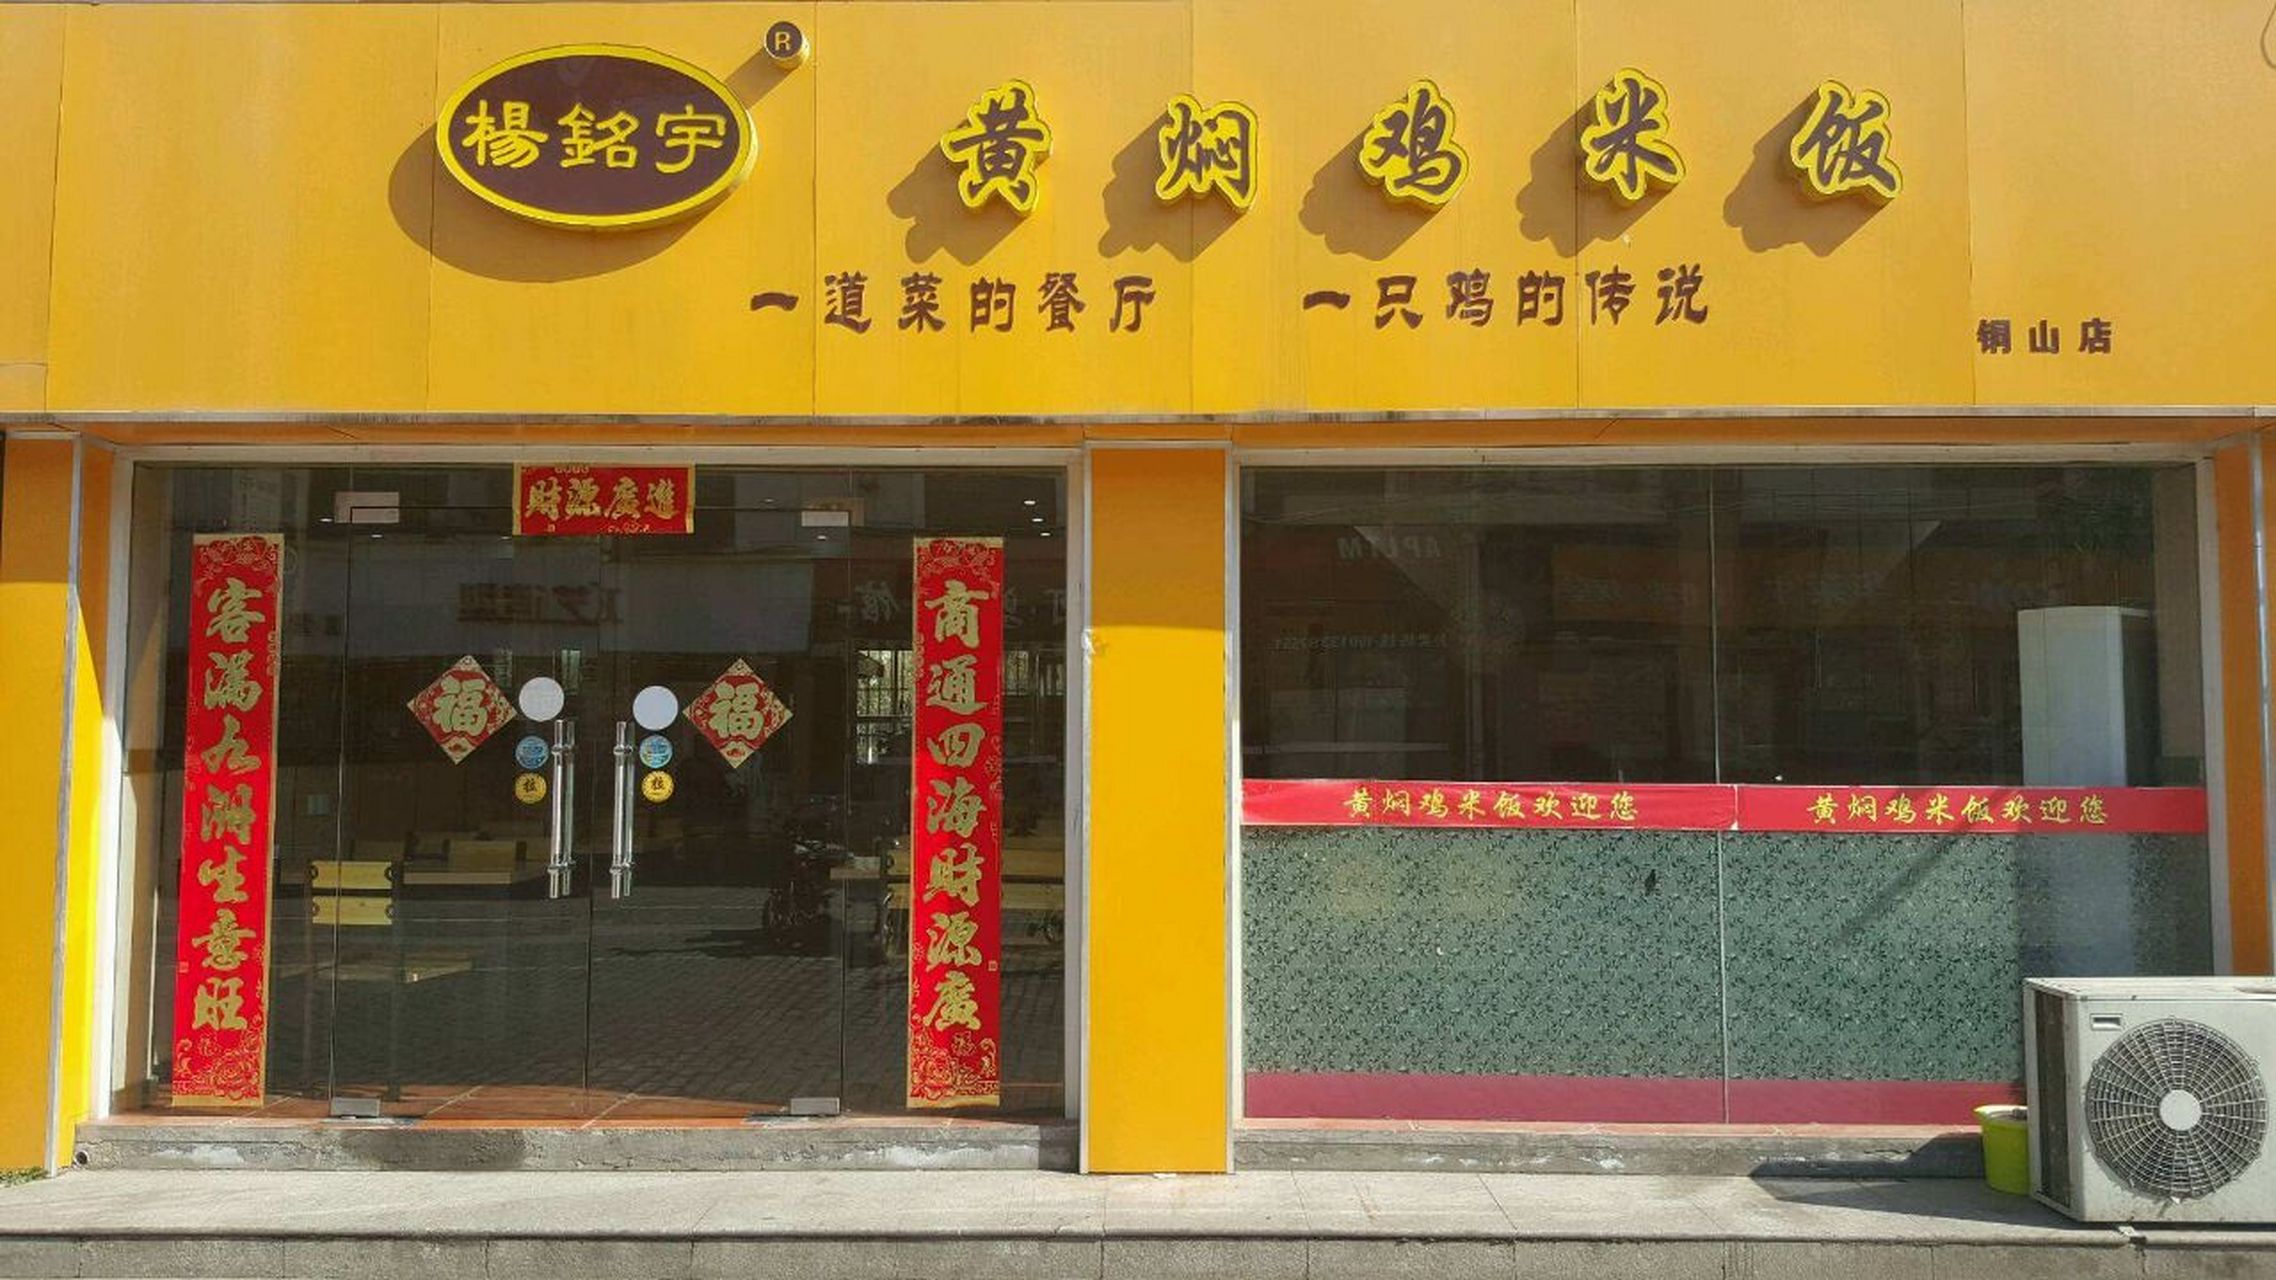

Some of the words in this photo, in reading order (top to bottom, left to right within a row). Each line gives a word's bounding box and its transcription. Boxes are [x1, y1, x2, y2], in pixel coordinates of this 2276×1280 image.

[461, 99, 727, 173] 楊銘宇
[941, 69, 1901, 213] 黄焖鸡米饭
[750, 271, 1156, 334] 一道菜的餐厅
[1301, 263, 1709, 329] 一只鸡的传说
[1976, 316, 2112, 354] 铜山店
[432, 674, 489, 737] 福
[708, 681, 764, 740] 福
[1343, 788, 1639, 821] 黄焖鸡米饭欢迎您
[1806, 793, 2109, 824] 黄焖鸡米饭欢迎您
